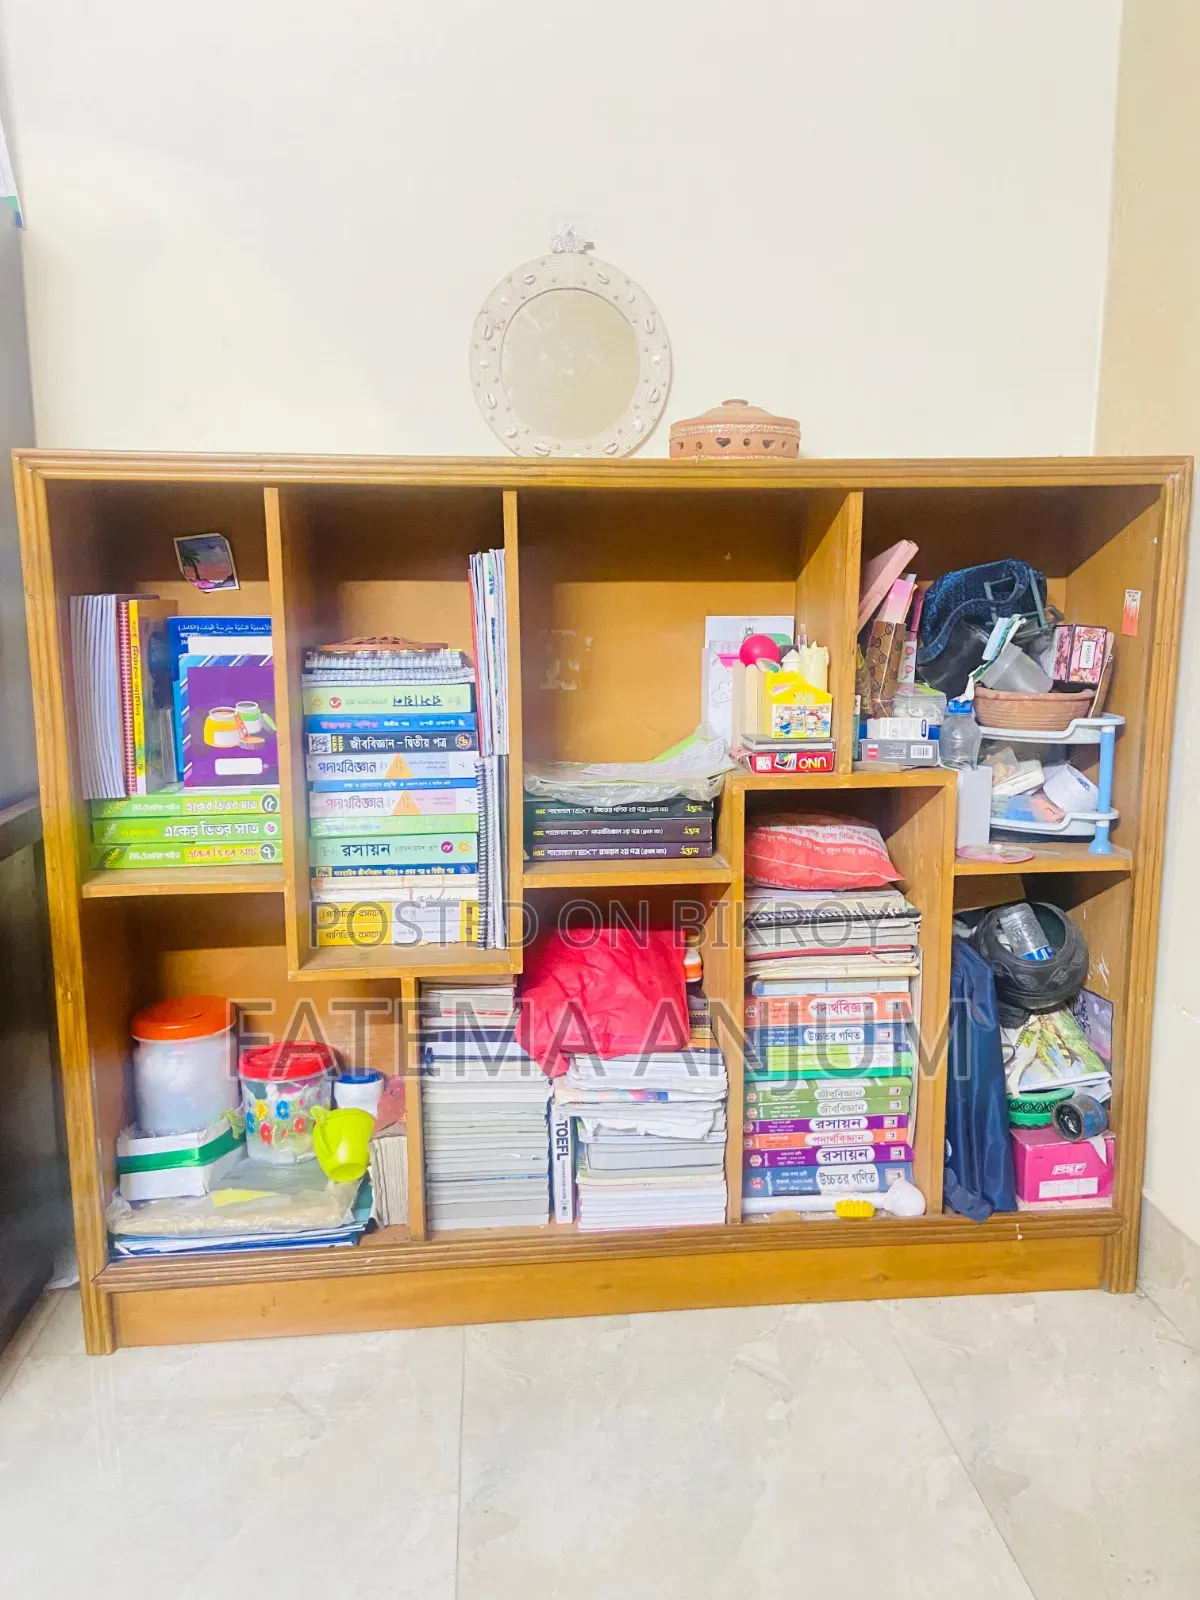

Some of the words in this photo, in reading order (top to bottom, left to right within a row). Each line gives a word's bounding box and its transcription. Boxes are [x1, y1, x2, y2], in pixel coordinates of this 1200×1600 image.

[393, 695, 443, 707] রসায়ন
[350, 734, 394, 750] জীববিজ্ঞান
[404, 735, 430, 749] দ্বিতীয়
[433, 736, 447, 750] পত্র
[318, 759, 377, 773] পদার্থবিজ্ঞান
[799, 757, 827, 769] UNO
[186, 800, 212, 812] একের
[264, 797, 275, 811] ৫
[325, 794, 384, 810] পদার্থবিজ্ঞান
[164, 825, 198, 839] একের
[199, 819, 232, 837] ভিতর
[233, 823, 260, 835] সাত
[267, 824, 275, 832] ৬
[262, 847, 272, 859] ৭
[341, 842, 392, 857] রসায়ন
[810, 999, 874, 1015] পদার্থবিজ্ঞান
[807, 1030, 836, 1042] উচ্চতর
[838, 1028, 861, 1042] গণিত
[816, 1088, 863, 1100] জীববিজ্ঞান
[819, 1102, 865, 1115] জীববিজ্ঞান
[815, 1117, 862, 1129] রসায়ন
[556, 1121, 569, 1160] TOEFL
[812, 1133, 864, 1145] পদার্থবিজ্ঞান
[821, 1149, 868, 1162] রসায়ন
[819, 1171, 849, 1187] উচ্চতর
[851, 1170, 876, 1185] গণিত
